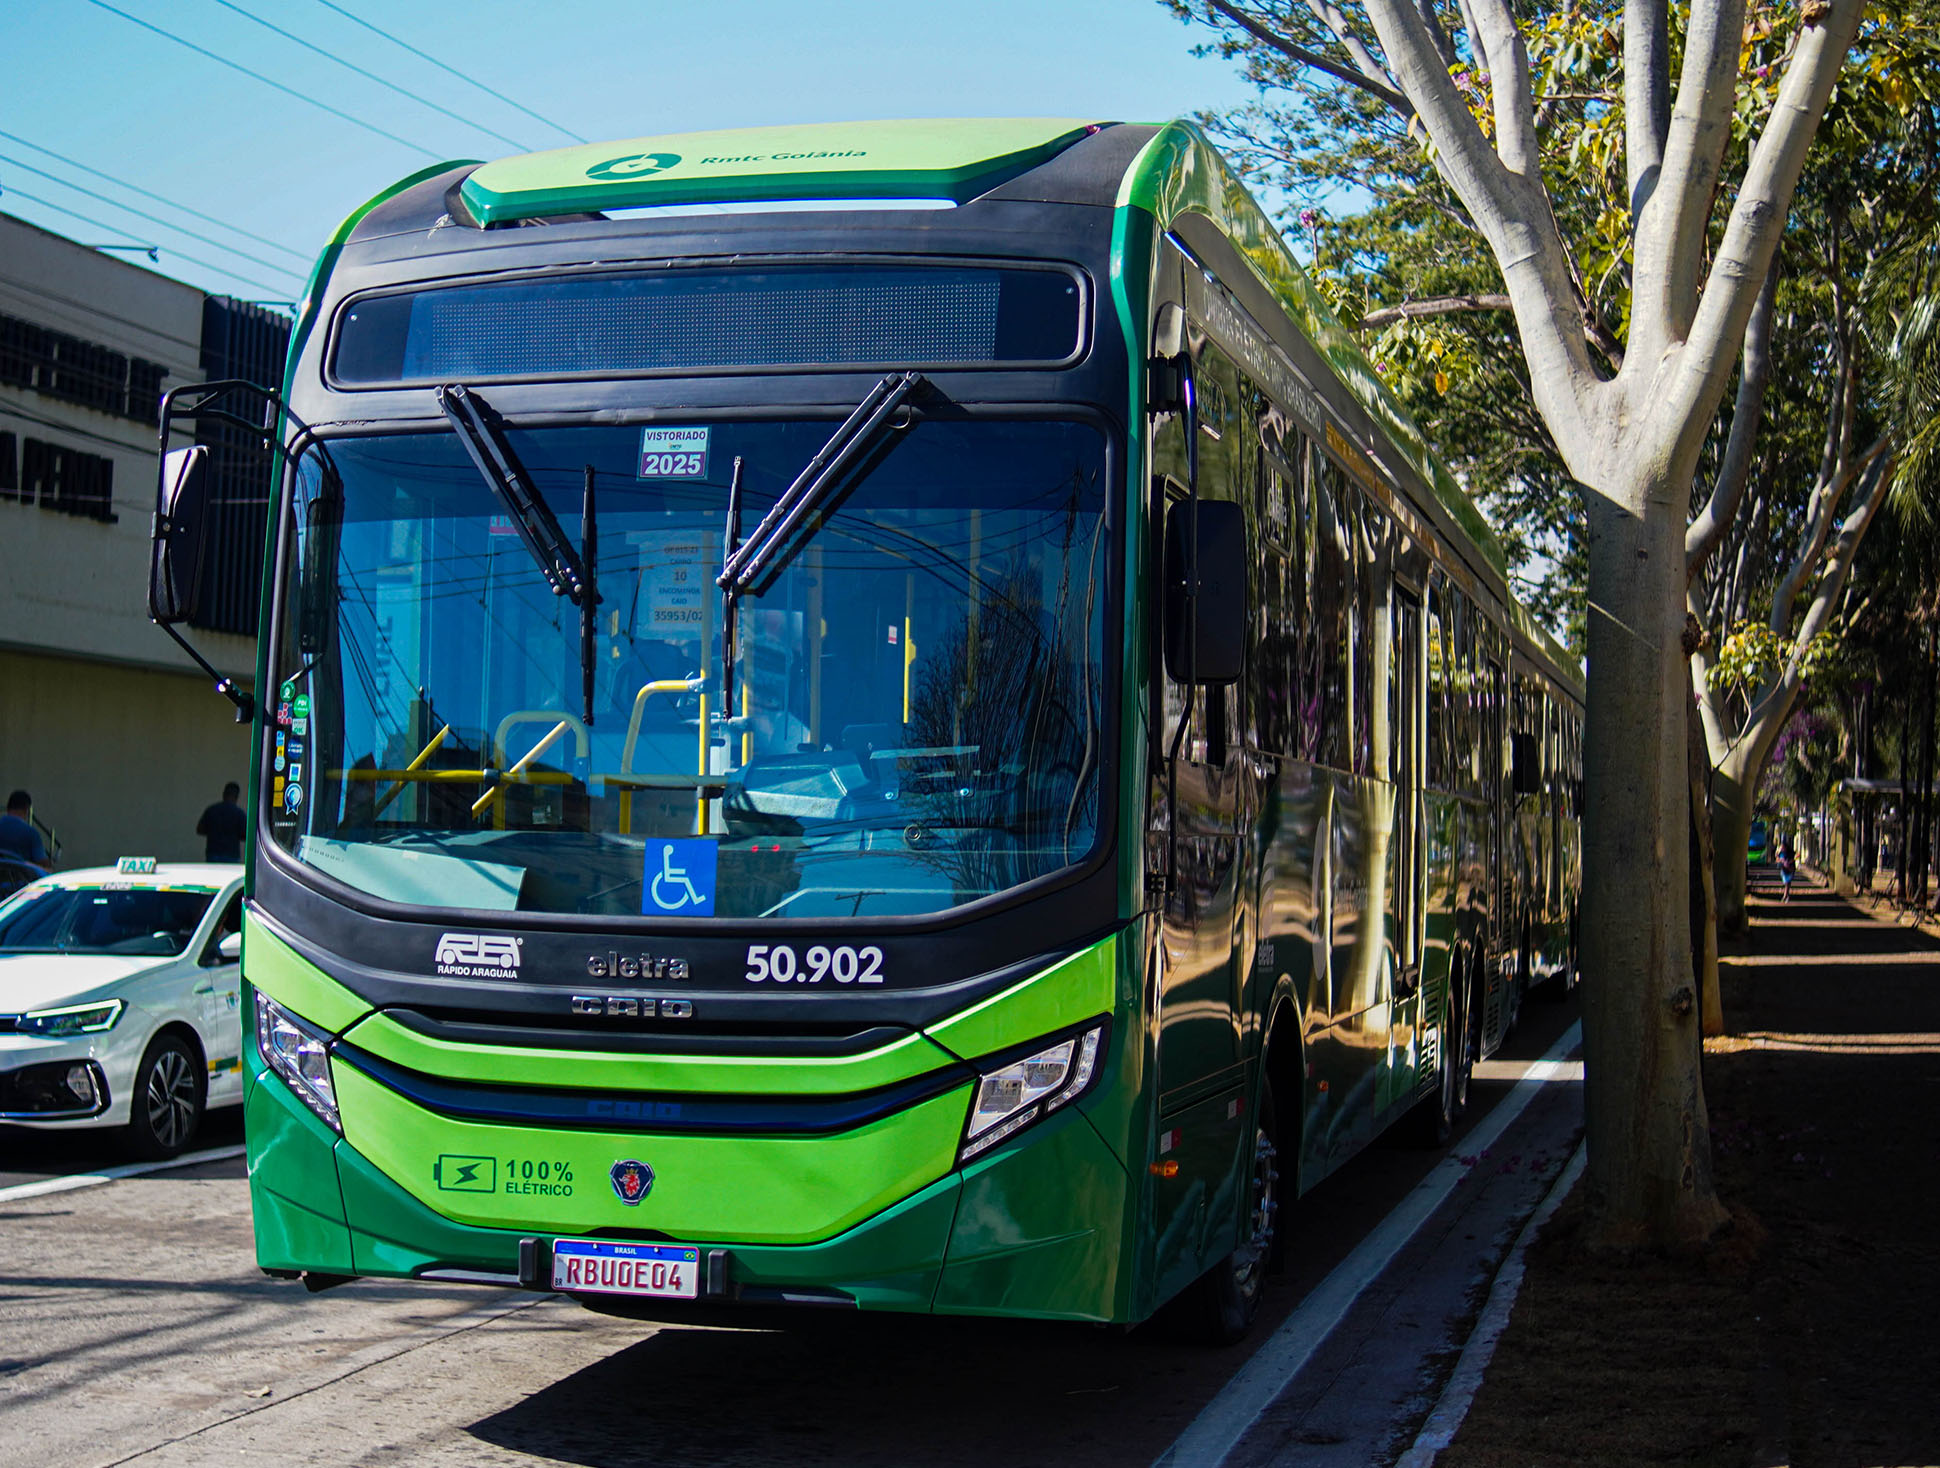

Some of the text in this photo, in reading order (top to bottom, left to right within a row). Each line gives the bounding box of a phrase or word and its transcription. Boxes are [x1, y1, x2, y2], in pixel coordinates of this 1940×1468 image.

[699, 149, 868, 165] Rmtc Goiânia
[646, 430, 707, 442] VISTORIADO
[644, 453, 702, 476] 2025
[675, 571, 687, 581] 10
[121, 860, 153, 873] TAXI
[437, 964, 518, 979] RÁPIDO ARAGUAIA
[585, 950, 690, 980] eletra
[745, 945, 884, 984] 50.902
[505, 1159, 574, 1182] 100%
[505, 1180, 573, 1197] ELÉTRICO
[614, 1246, 638, 1256] BRASIL
[554, 1277, 563, 1288] BR
